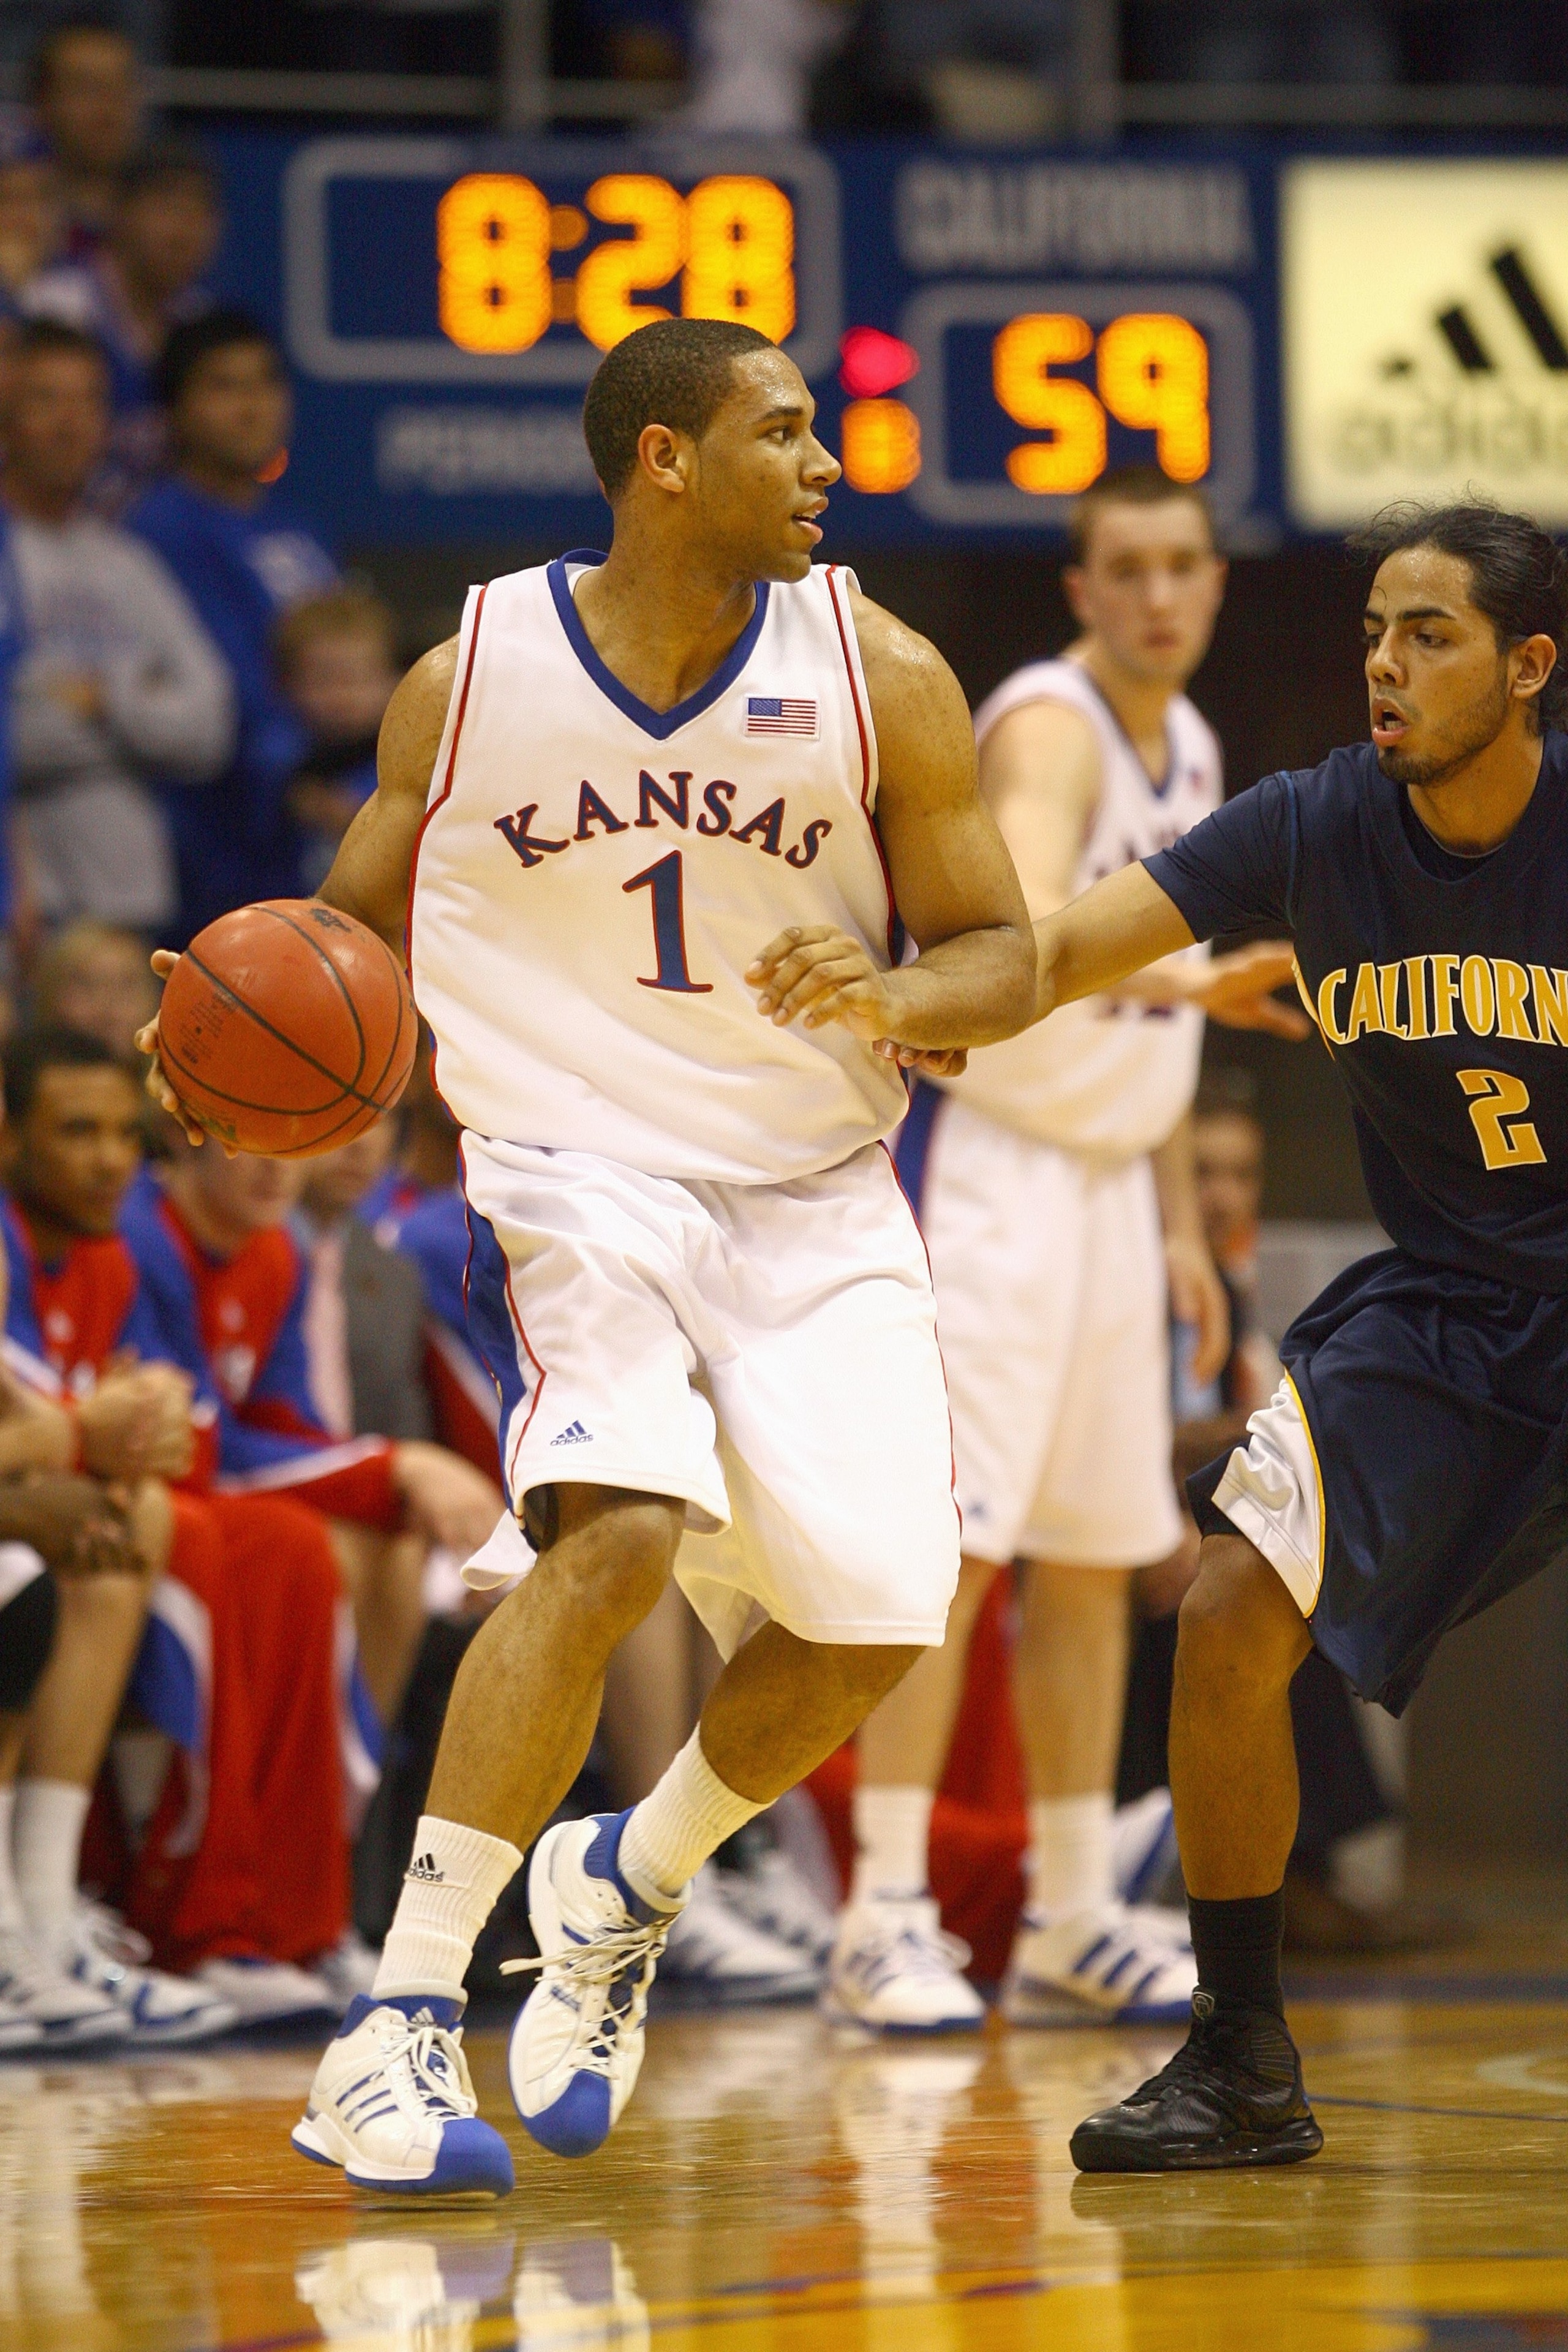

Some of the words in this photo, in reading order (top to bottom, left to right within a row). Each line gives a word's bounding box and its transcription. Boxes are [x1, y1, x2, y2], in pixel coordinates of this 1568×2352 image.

[437, 173, 796, 354] 8:28
[993, 313, 1211, 494] 59
[493, 769, 833, 869] KANSAS
[622, 850, 714, 993] 1
[1317, 954, 1568, 1047] CALIFORN
[1456, 1069, 1547, 1170] 2
[550, 1434, 594, 1446] adidas
